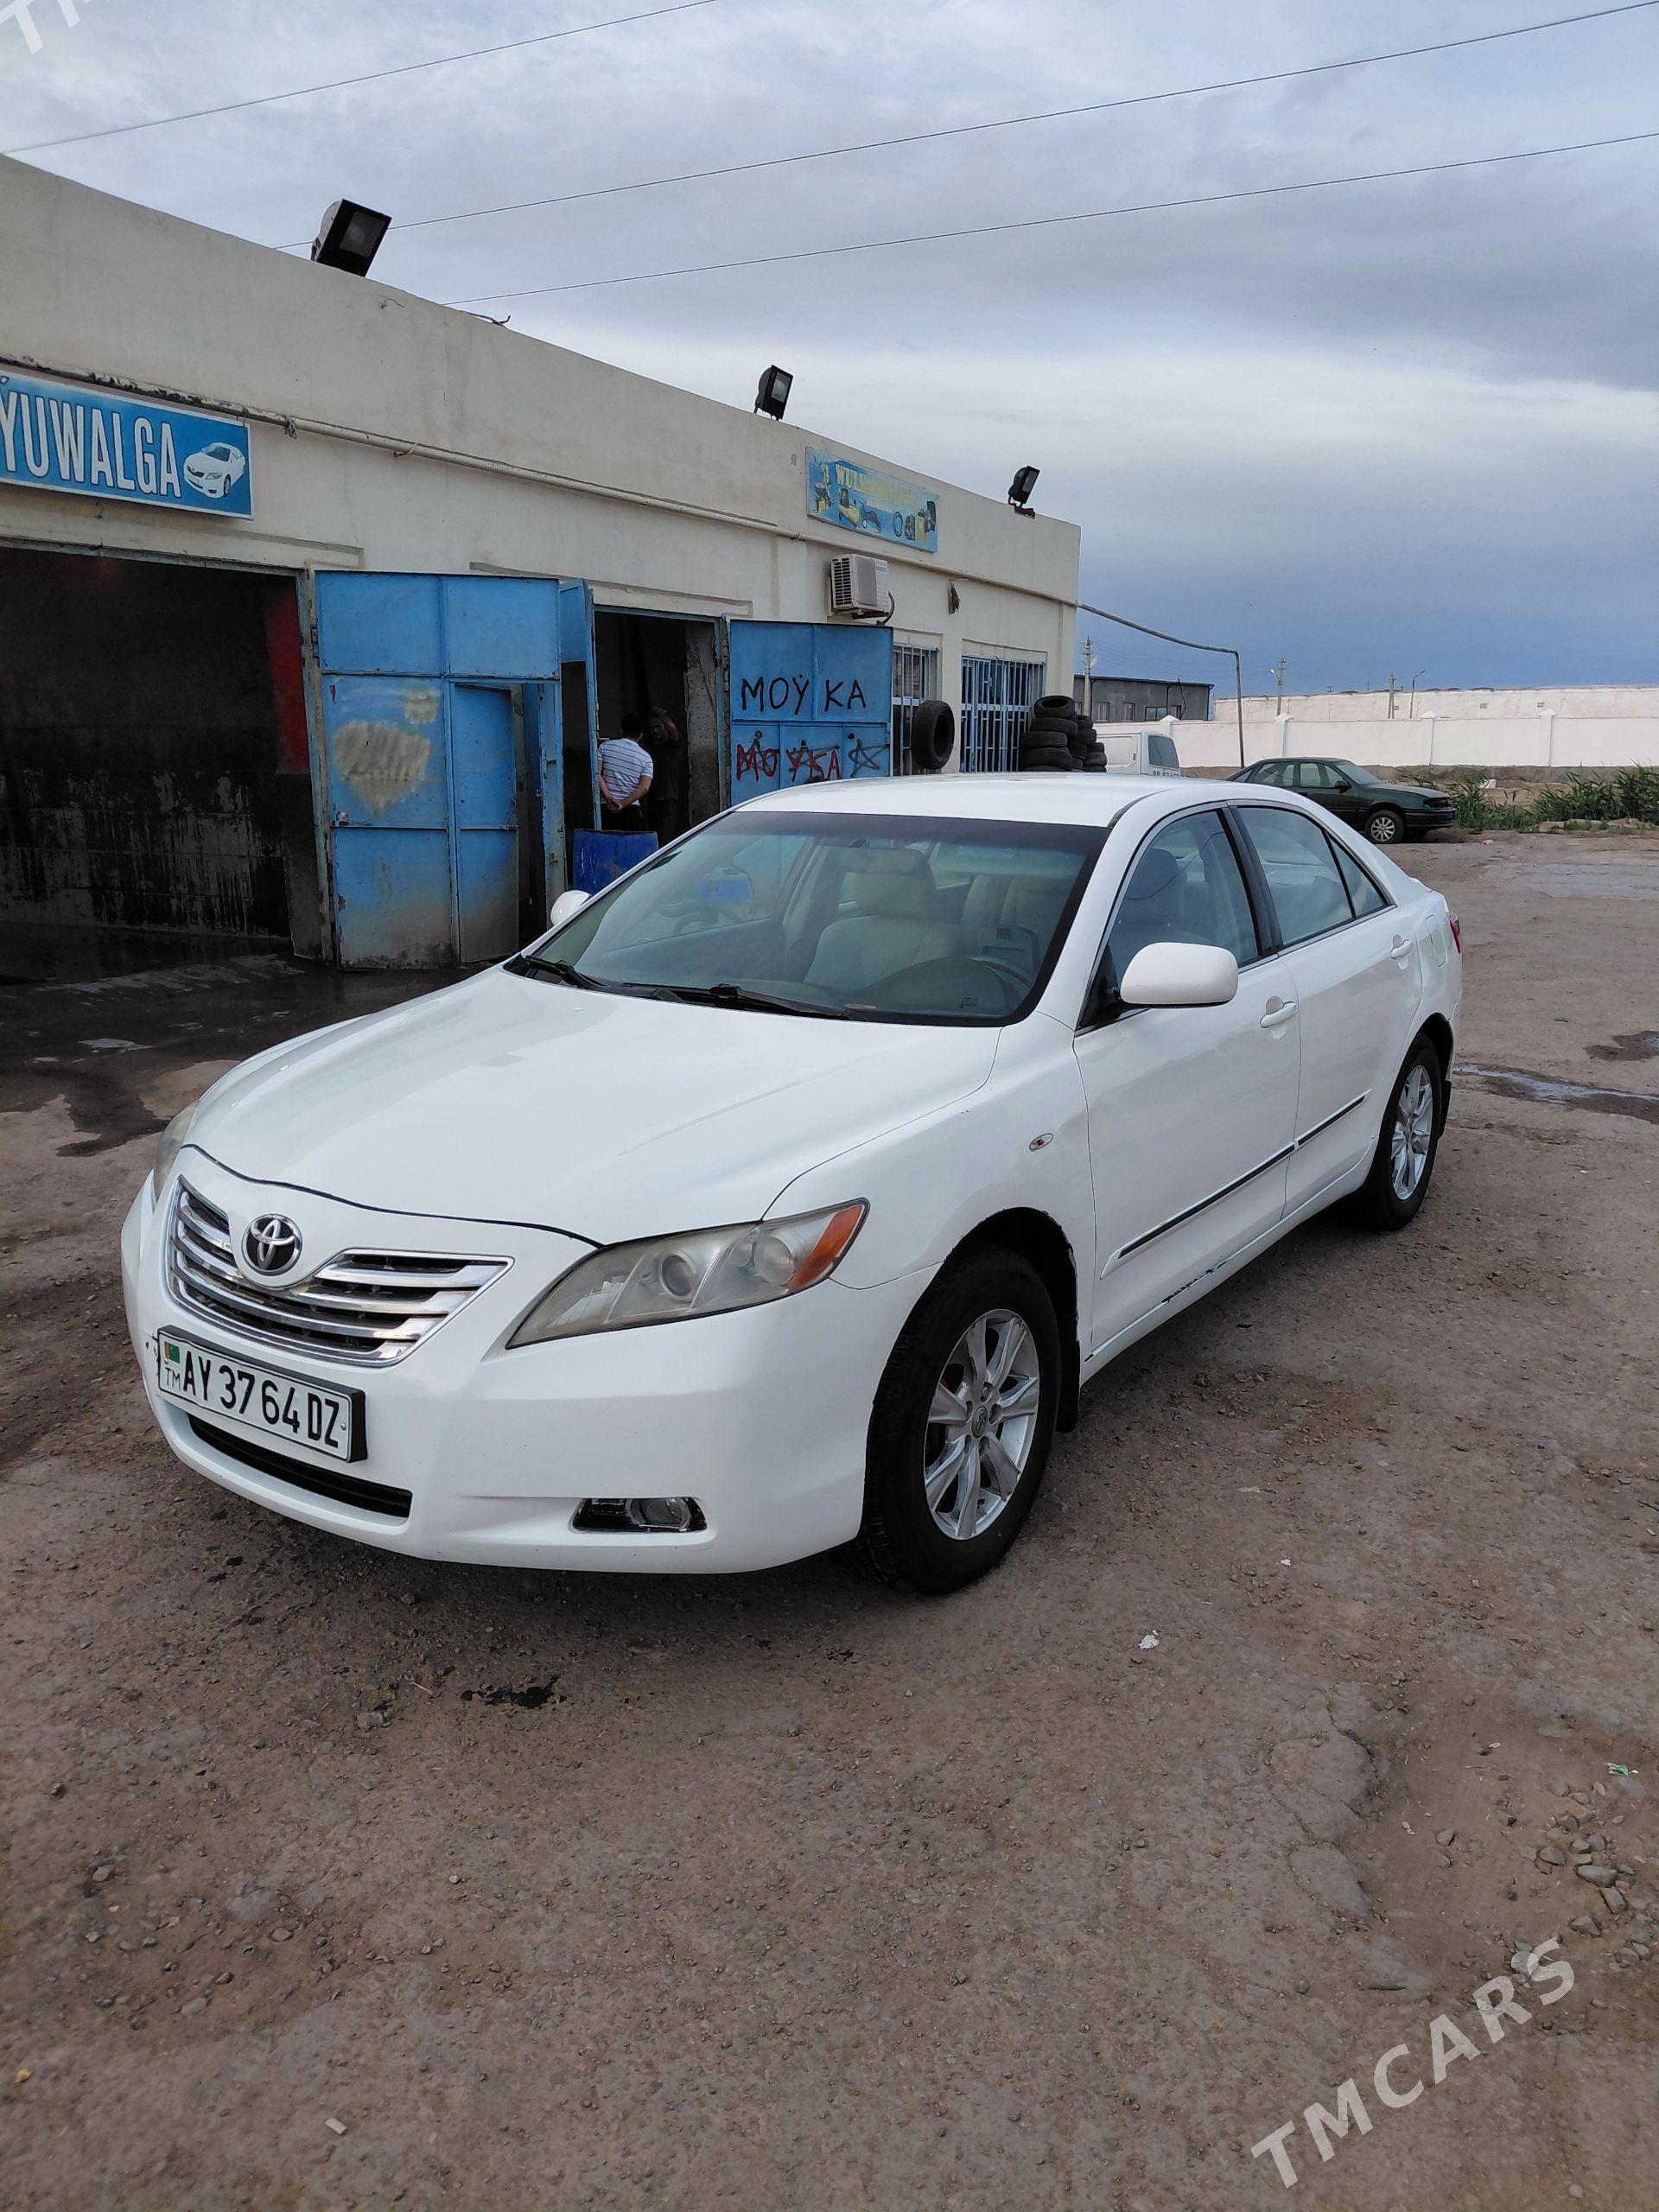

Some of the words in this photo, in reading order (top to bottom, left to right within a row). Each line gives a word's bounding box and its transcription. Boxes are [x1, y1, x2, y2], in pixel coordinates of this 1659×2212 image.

[164, 1367, 181, 1391] TM
[183, 1351, 211, 1402] AY
[307, 1391, 340, 1449] DZ
